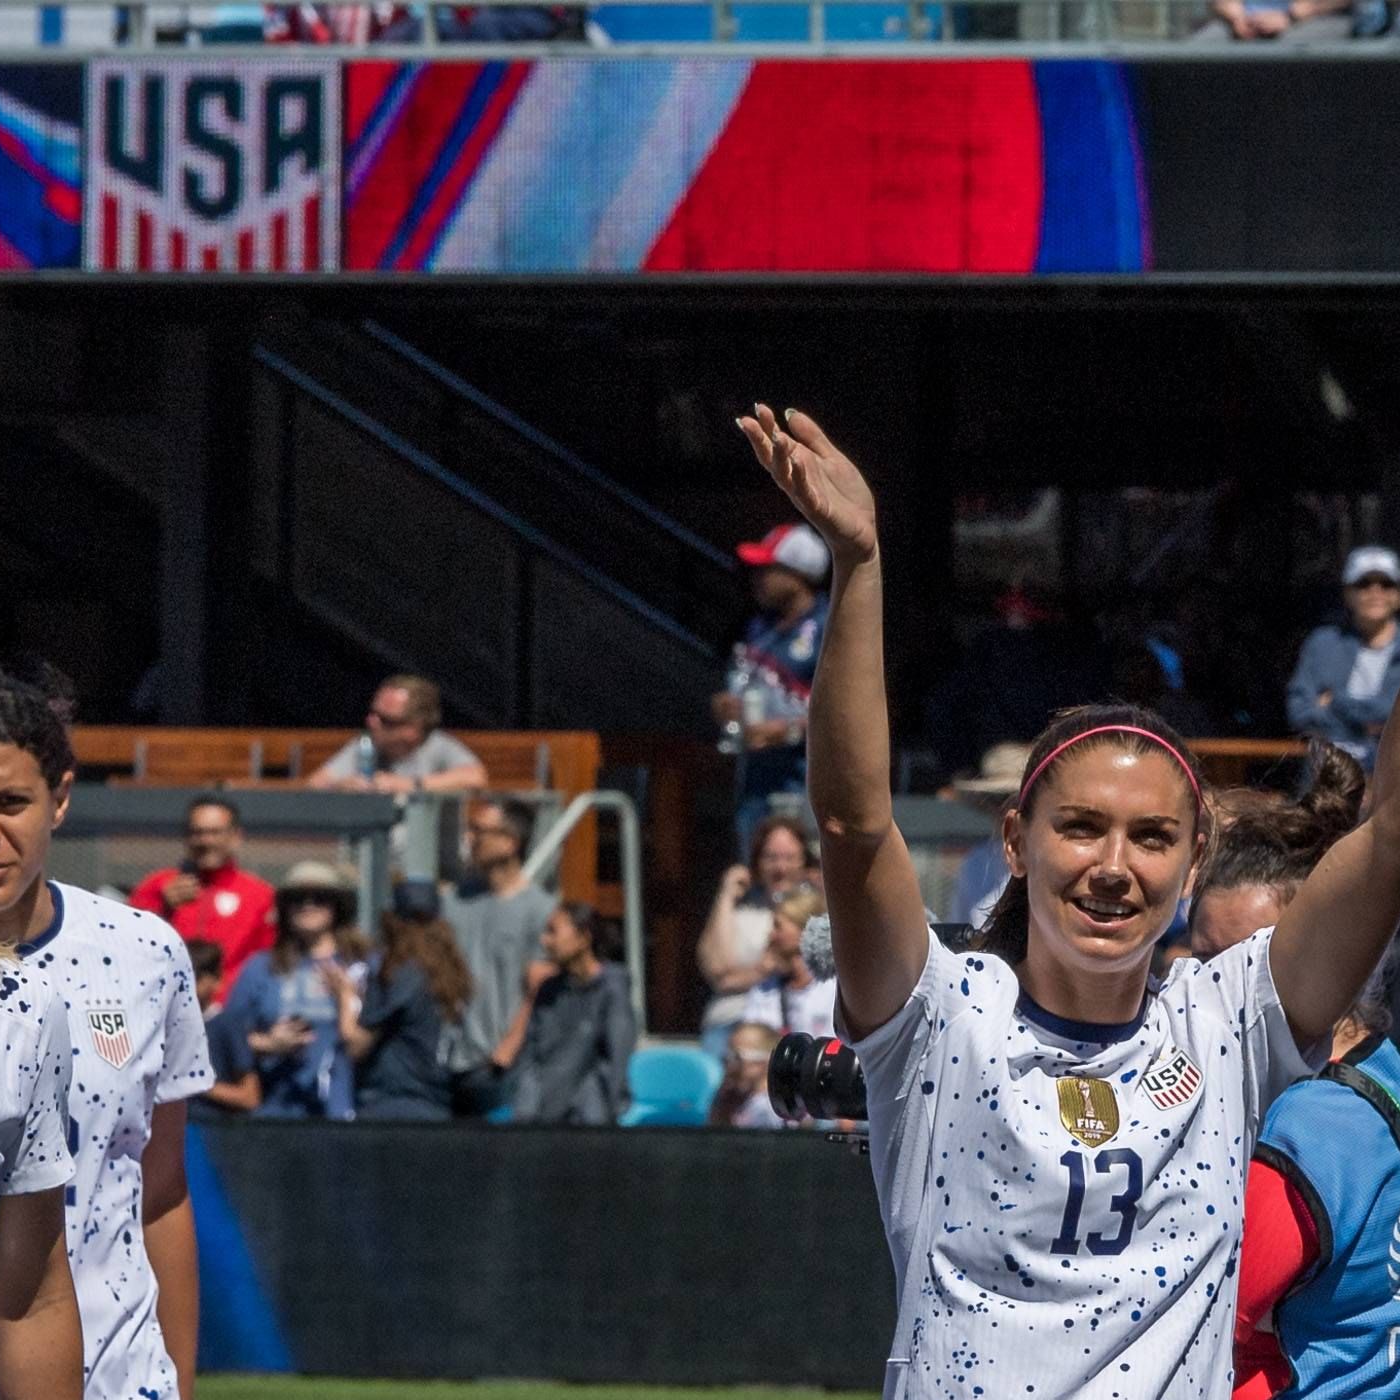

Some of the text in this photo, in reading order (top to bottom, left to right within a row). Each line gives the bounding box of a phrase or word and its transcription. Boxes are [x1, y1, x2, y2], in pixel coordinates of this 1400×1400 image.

[104, 74, 322, 222] USA
[90, 1013, 125, 1035] USA
[1144, 1056, 1188, 1091] USA
[1077, 1118, 1105, 1130] FIFA
[1050, 1147, 1143, 1256] 13
